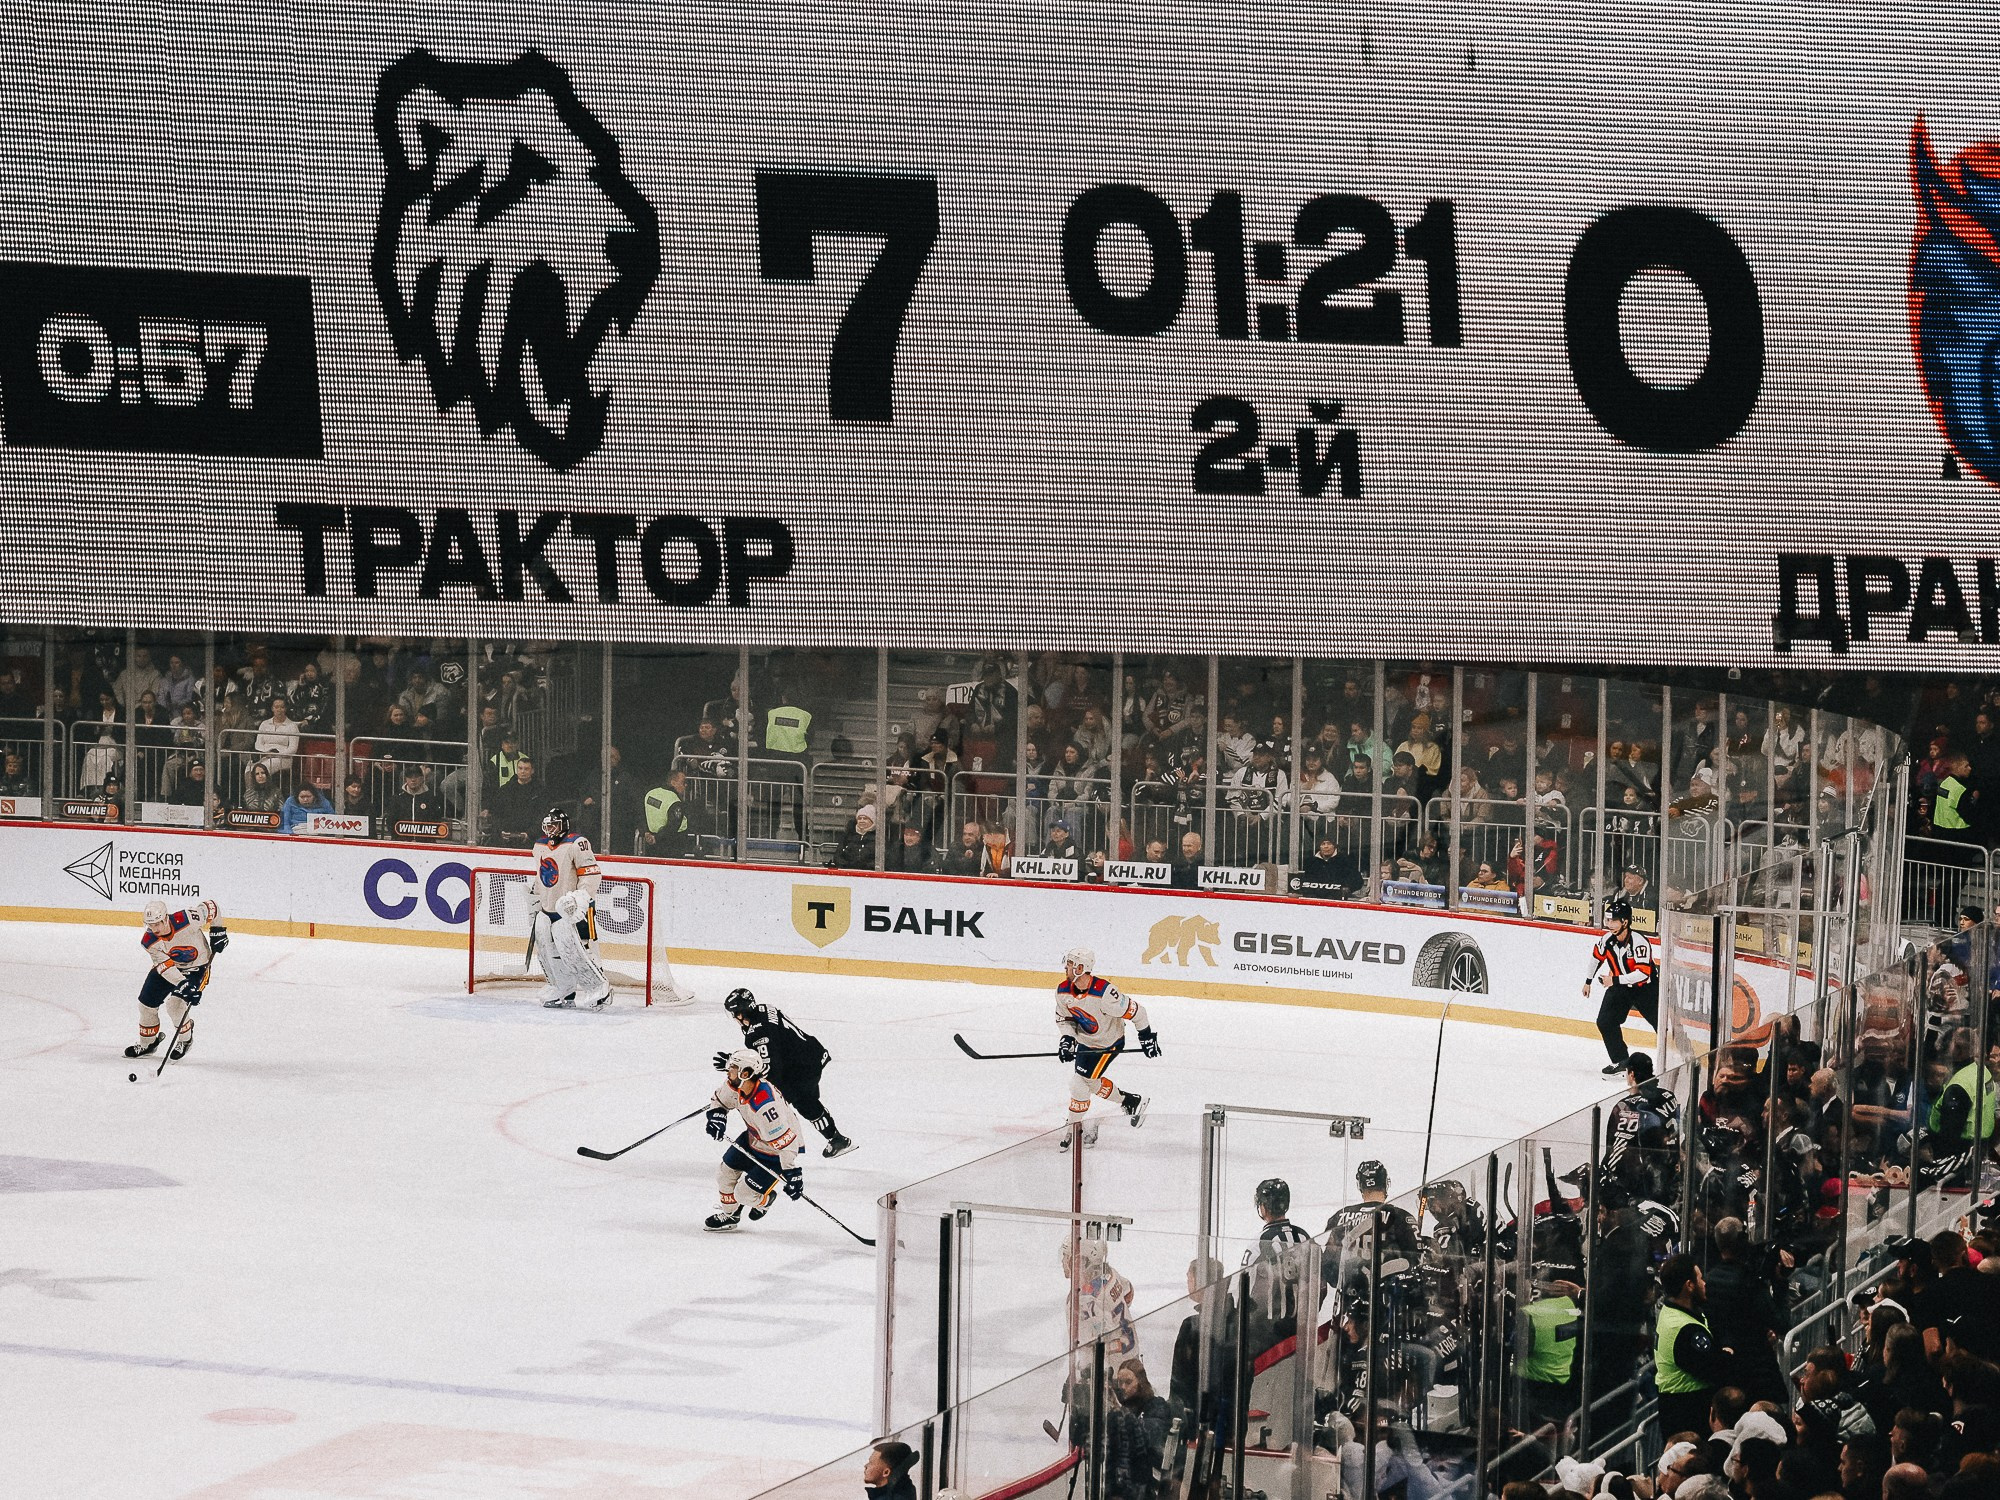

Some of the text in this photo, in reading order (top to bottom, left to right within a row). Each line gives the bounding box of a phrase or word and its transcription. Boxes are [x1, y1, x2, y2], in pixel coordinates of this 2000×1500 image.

[1061, 183, 1463, 346] 01:21
[755, 167, 939, 421] 7
[1564, 203, 1764, 454] 0
[37, 313, 268, 409] 0:57
[276, 501, 796, 608] ТРАКТОР
[67, 805, 106, 816] WINLINE
[231, 814, 270, 824] WINLINE
[399, 824, 437, 834] WINLINE
[119, 851, 183, 866] РУССКАЯ
[119, 866, 181, 881] МЕДНАЯ
[1015, 861, 1073, 875] KHL.RU
[1108, 865, 1167, 880] KHL.RU
[1202, 871, 1261, 886] KHL.RU
[1302, 881, 1341, 891] SOYUZ
[119, 881, 200, 897] КОМПАНИЯ
[363, 858, 645, 934] СОГЗ
[1394, 888, 1442, 899] THUNDEROBOT
[1469, 895, 1514, 906] THUNDEROBOT
[1556, 905, 1580, 914] БАНК
[807, 902, 985, 938] Т БАНК
[1631, 915, 1647, 924] АНК
[1233, 931, 1406, 965] GISLAVED
[1636, 946, 1647, 958] 17
[1233, 964, 1353, 979] АВТОМОБИЛЬНЫЕ ШИНЫ
[1110, 988, 1120, 999] 5
[762, 1107, 779, 1123] 16
[1617, 1117, 1639, 1132] 20
[747, 1178, 762, 1190] CCM
[1366, 1178, 1375, 1187] 25
